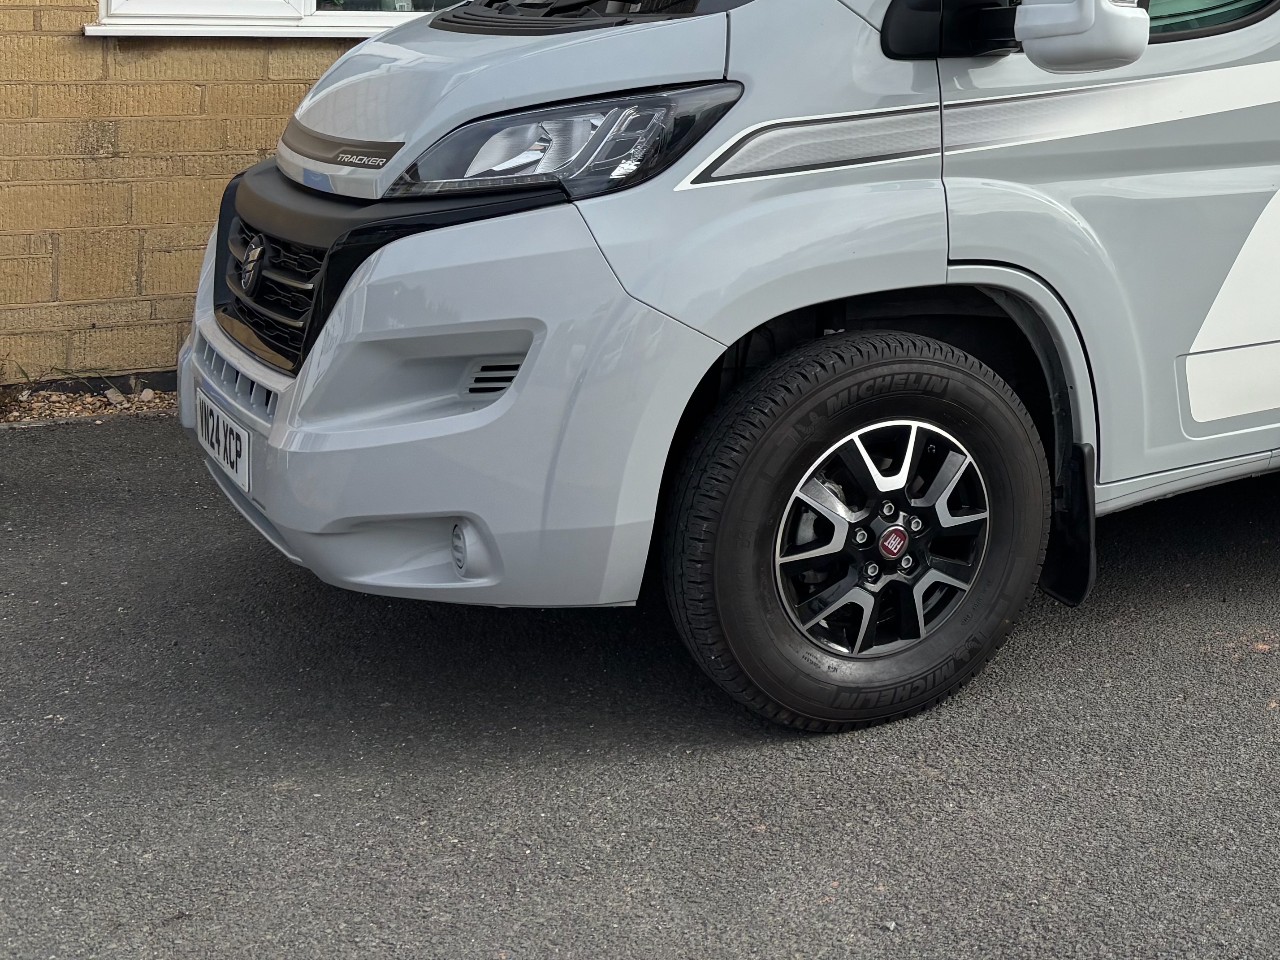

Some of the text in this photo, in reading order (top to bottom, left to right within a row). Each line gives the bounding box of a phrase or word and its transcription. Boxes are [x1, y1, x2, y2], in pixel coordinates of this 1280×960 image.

[337, 153, 387, 166] TRACKER
[826, 372, 949, 417] MICHELIN
[200, 398, 243, 474] VN24 XCP
[883, 532, 904, 554] FIAT
[832, 658, 957, 709] MICHELIN
